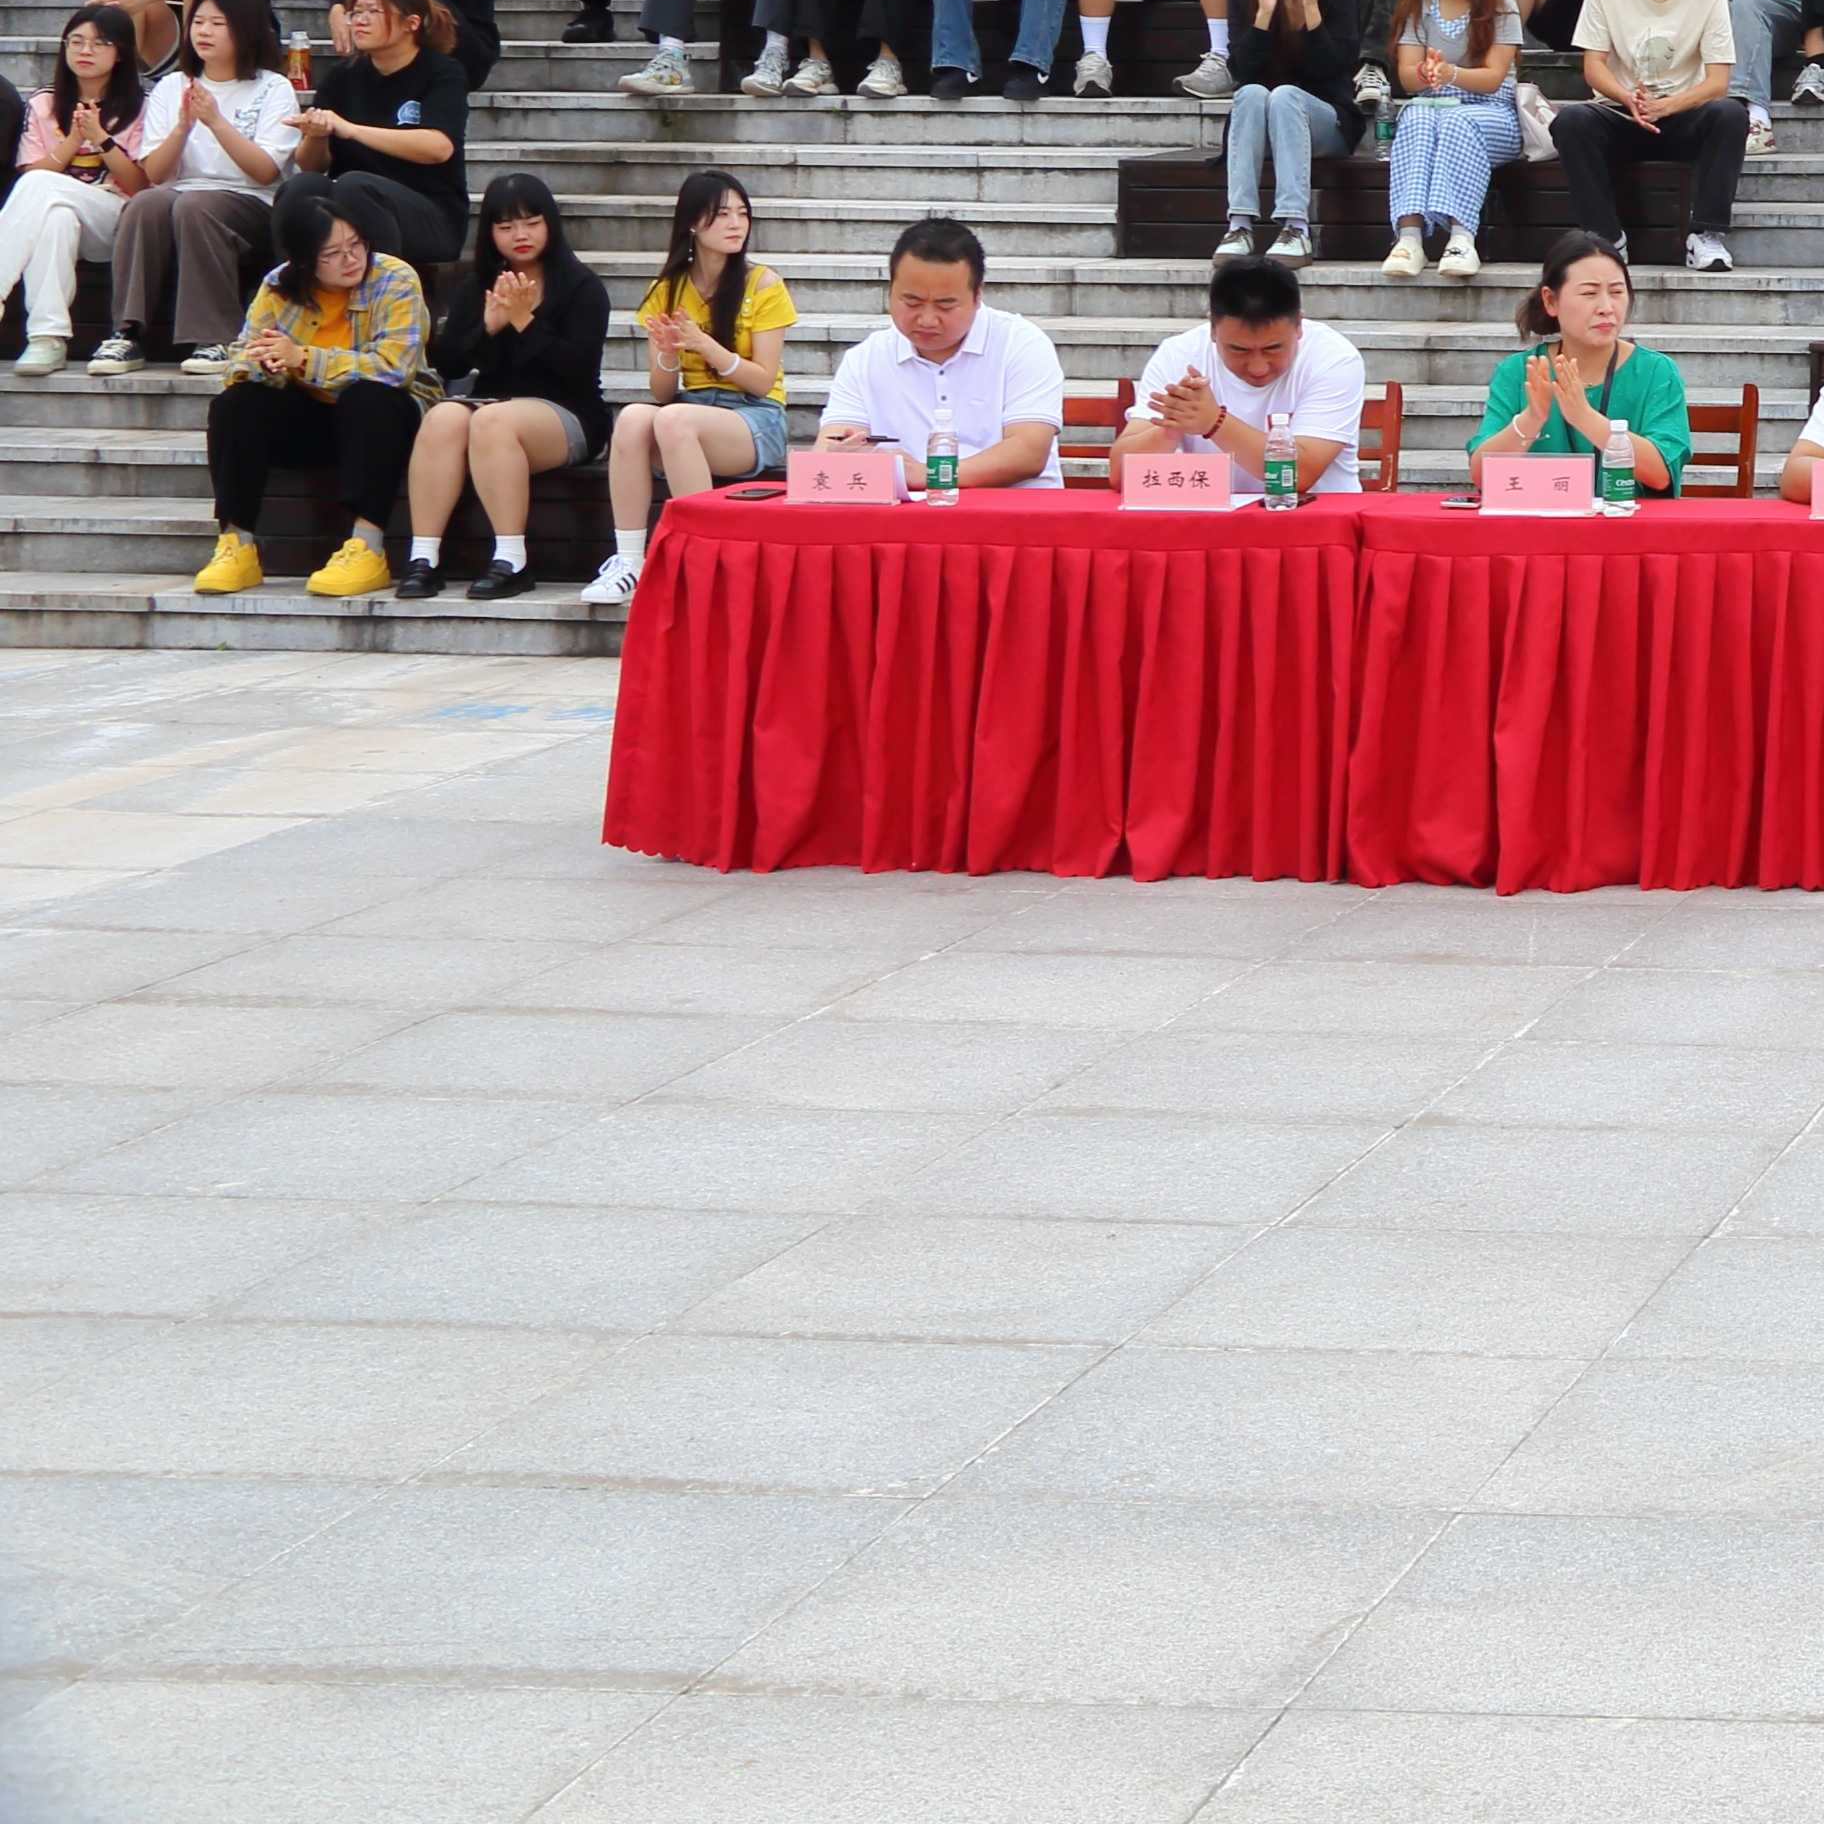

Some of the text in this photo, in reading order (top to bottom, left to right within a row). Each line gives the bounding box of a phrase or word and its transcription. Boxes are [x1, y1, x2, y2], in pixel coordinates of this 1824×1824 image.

[813, 470, 867, 491] 袁兵
[1142, 469, 1210, 489] 拉西保
[1505, 476, 1570, 492] 王丽
